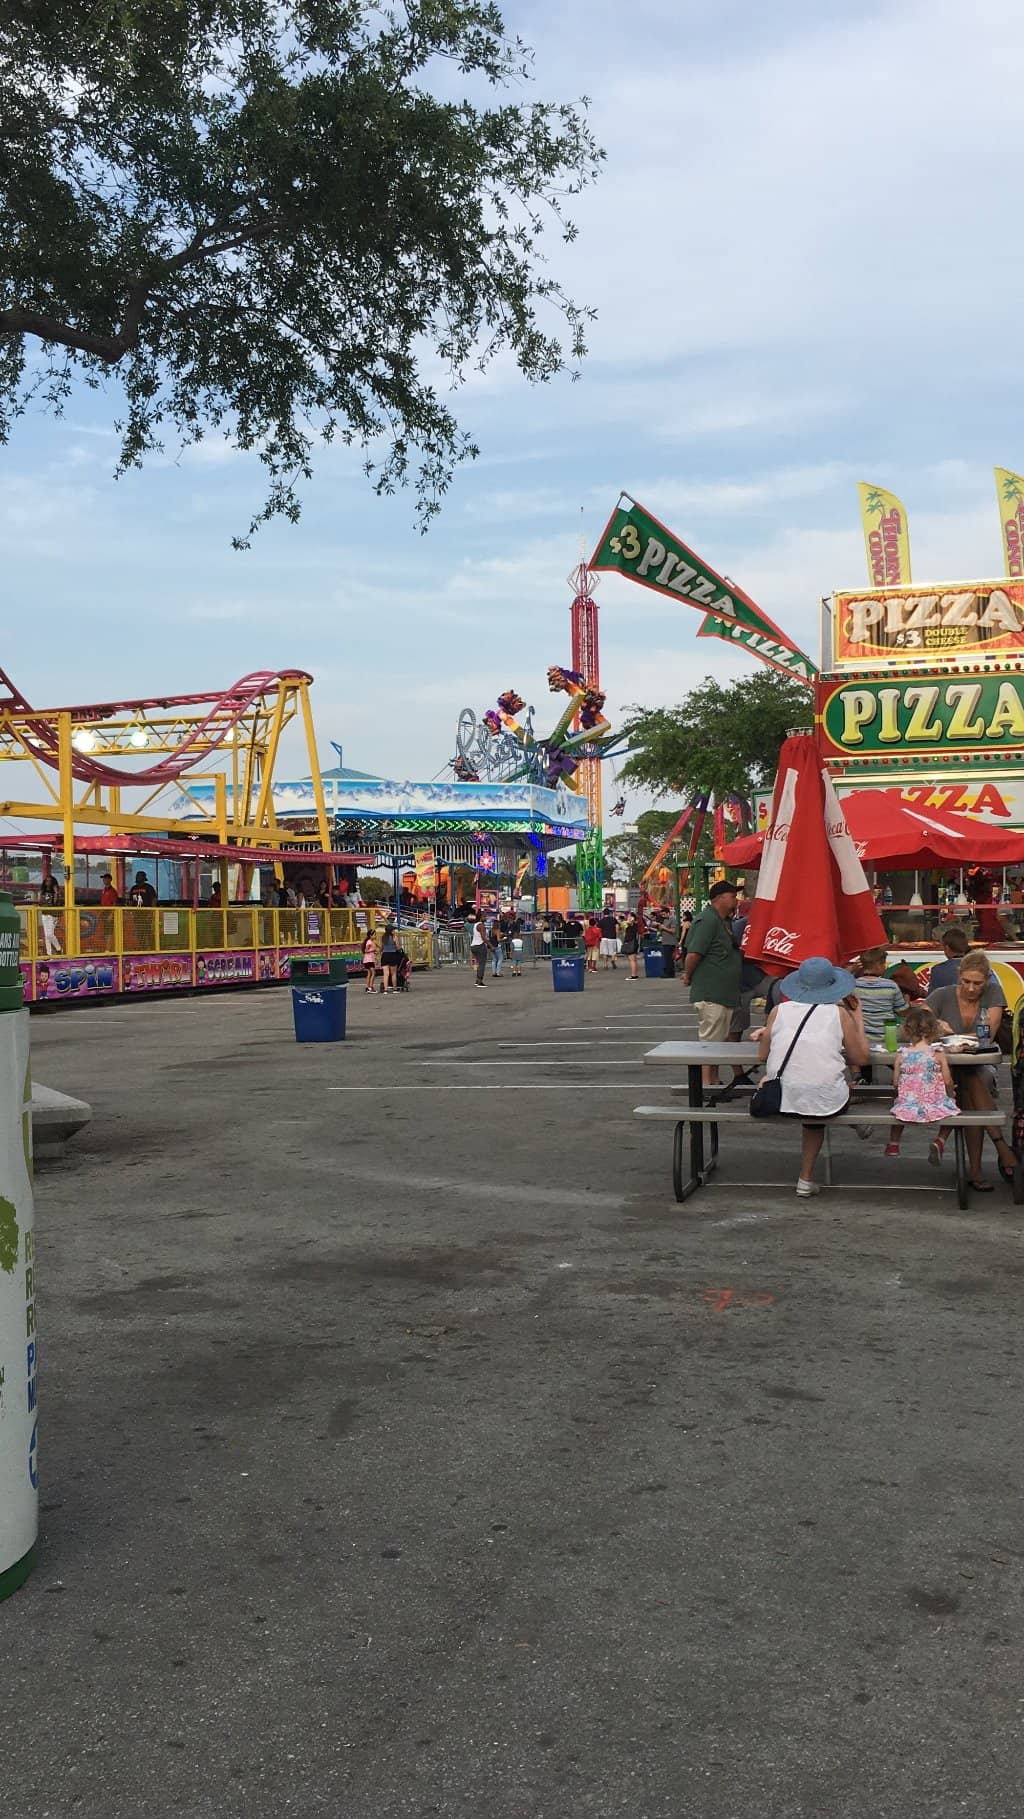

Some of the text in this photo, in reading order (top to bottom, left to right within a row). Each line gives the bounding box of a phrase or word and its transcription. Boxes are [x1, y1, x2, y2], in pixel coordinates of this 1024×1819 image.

[609, 525, 737, 617] $3 PIZZA
[848, 591, 1024, 642] PIZZA
[896, 628, 968, 647] $3 DOUBLE
[925, 637, 967, 646] CHEESE
[840, 682, 1024, 744] PIZZA
[207, 957, 252, 979] SCREAM
